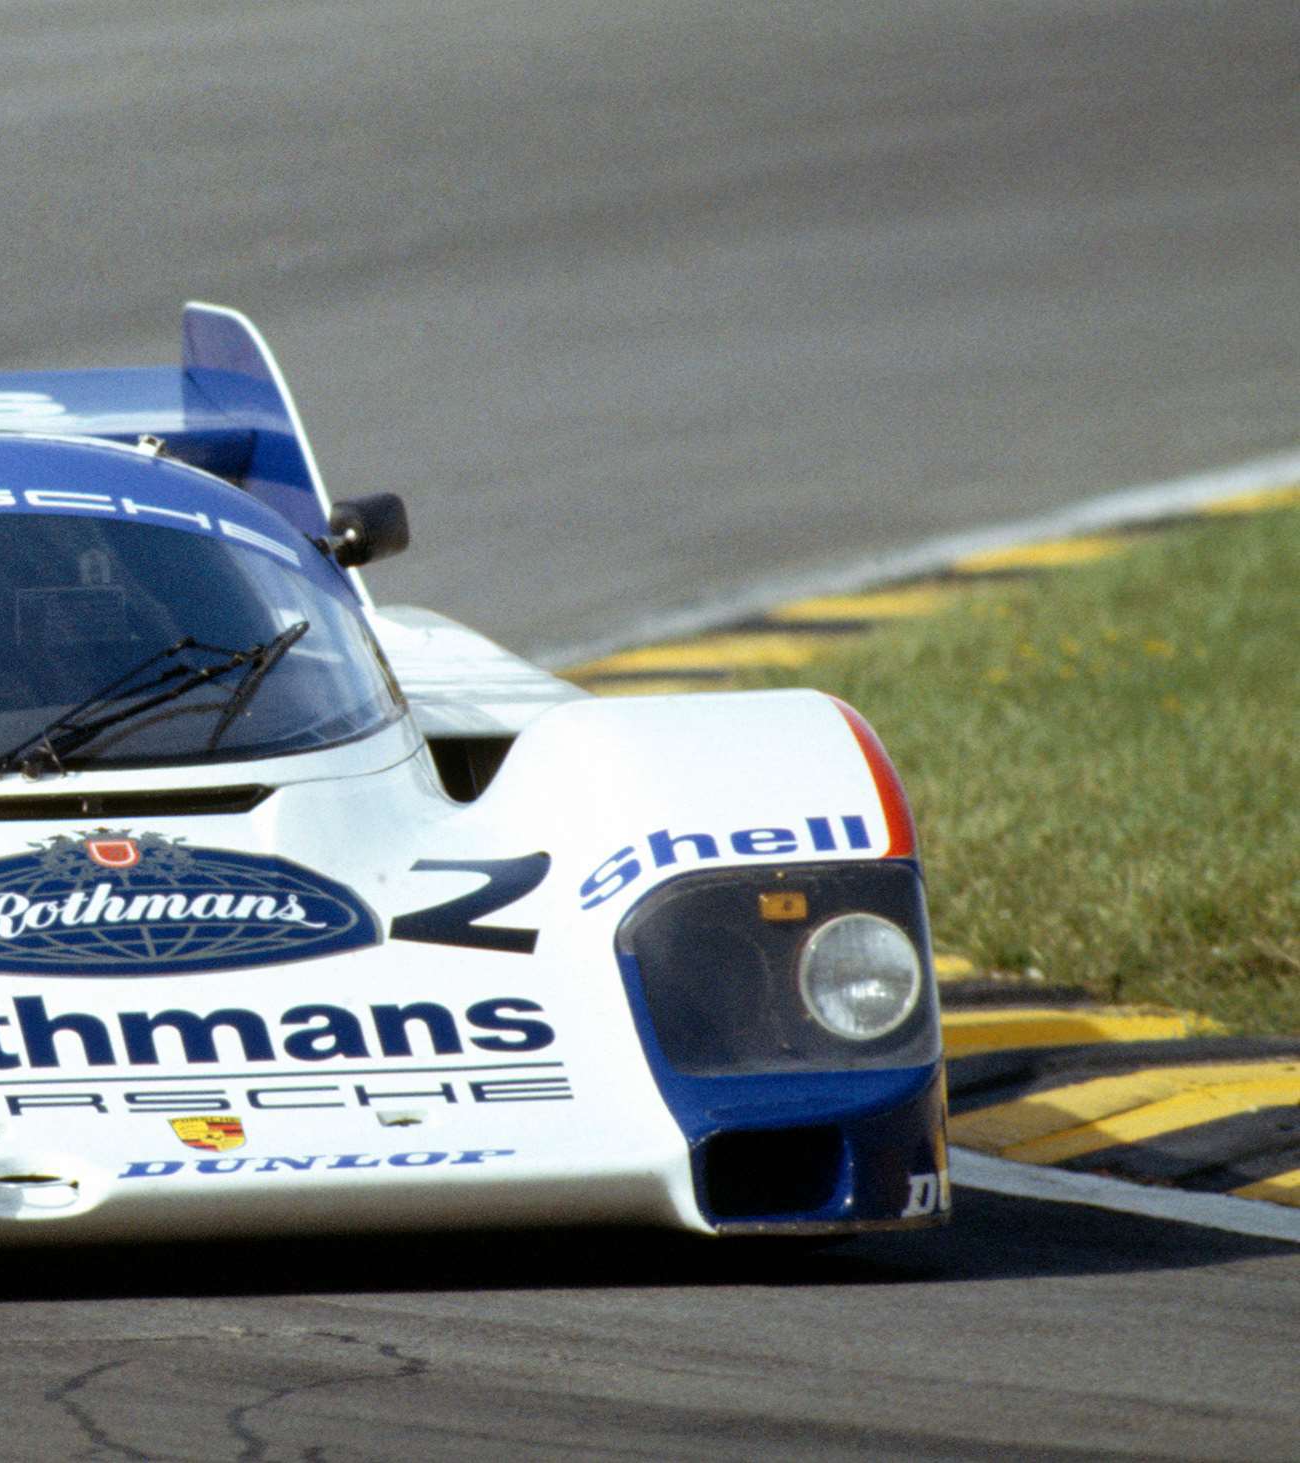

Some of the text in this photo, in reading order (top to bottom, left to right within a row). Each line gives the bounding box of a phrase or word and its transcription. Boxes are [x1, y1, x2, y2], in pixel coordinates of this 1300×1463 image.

[388, 851, 552, 954] 2
[579, 815, 872, 910] Shell
[118, 1148, 516, 1180] DUNLOP
